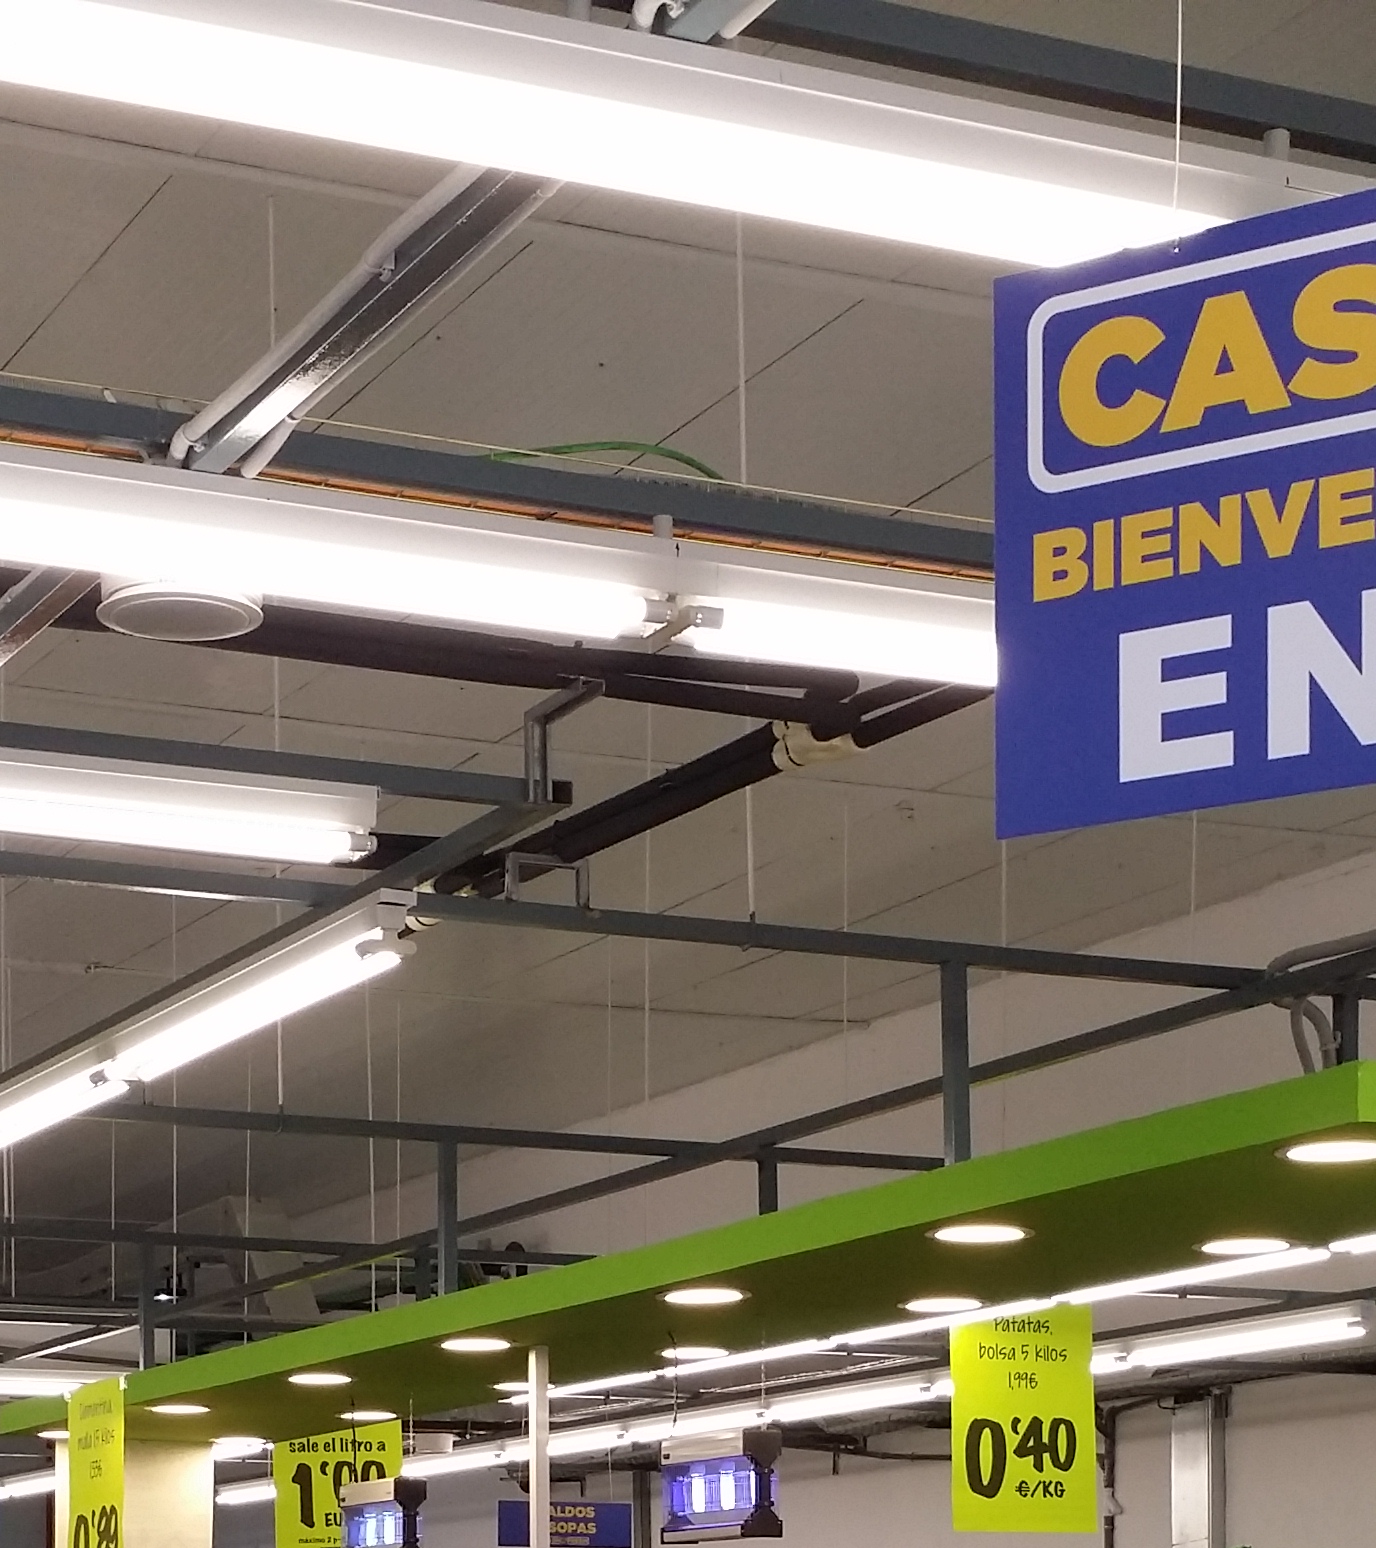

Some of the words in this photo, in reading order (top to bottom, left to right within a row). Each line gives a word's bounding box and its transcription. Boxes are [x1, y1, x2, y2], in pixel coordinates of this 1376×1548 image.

[979, 1342, 1015, 1360] bolsa
[1021, 1344, 1029, 1360] 5
[1035, 1345, 1067, 1362] kilos
[1009, 1371, 1038, 1390] 1,99€
[289, 1437, 319, 1453] sale
[324, 1438, 335, 1452] el
[340, 1438, 372, 1452] litro
[377, 1441, 385, 1451] a
[1015, 1480, 1065, 1498] €/KG
